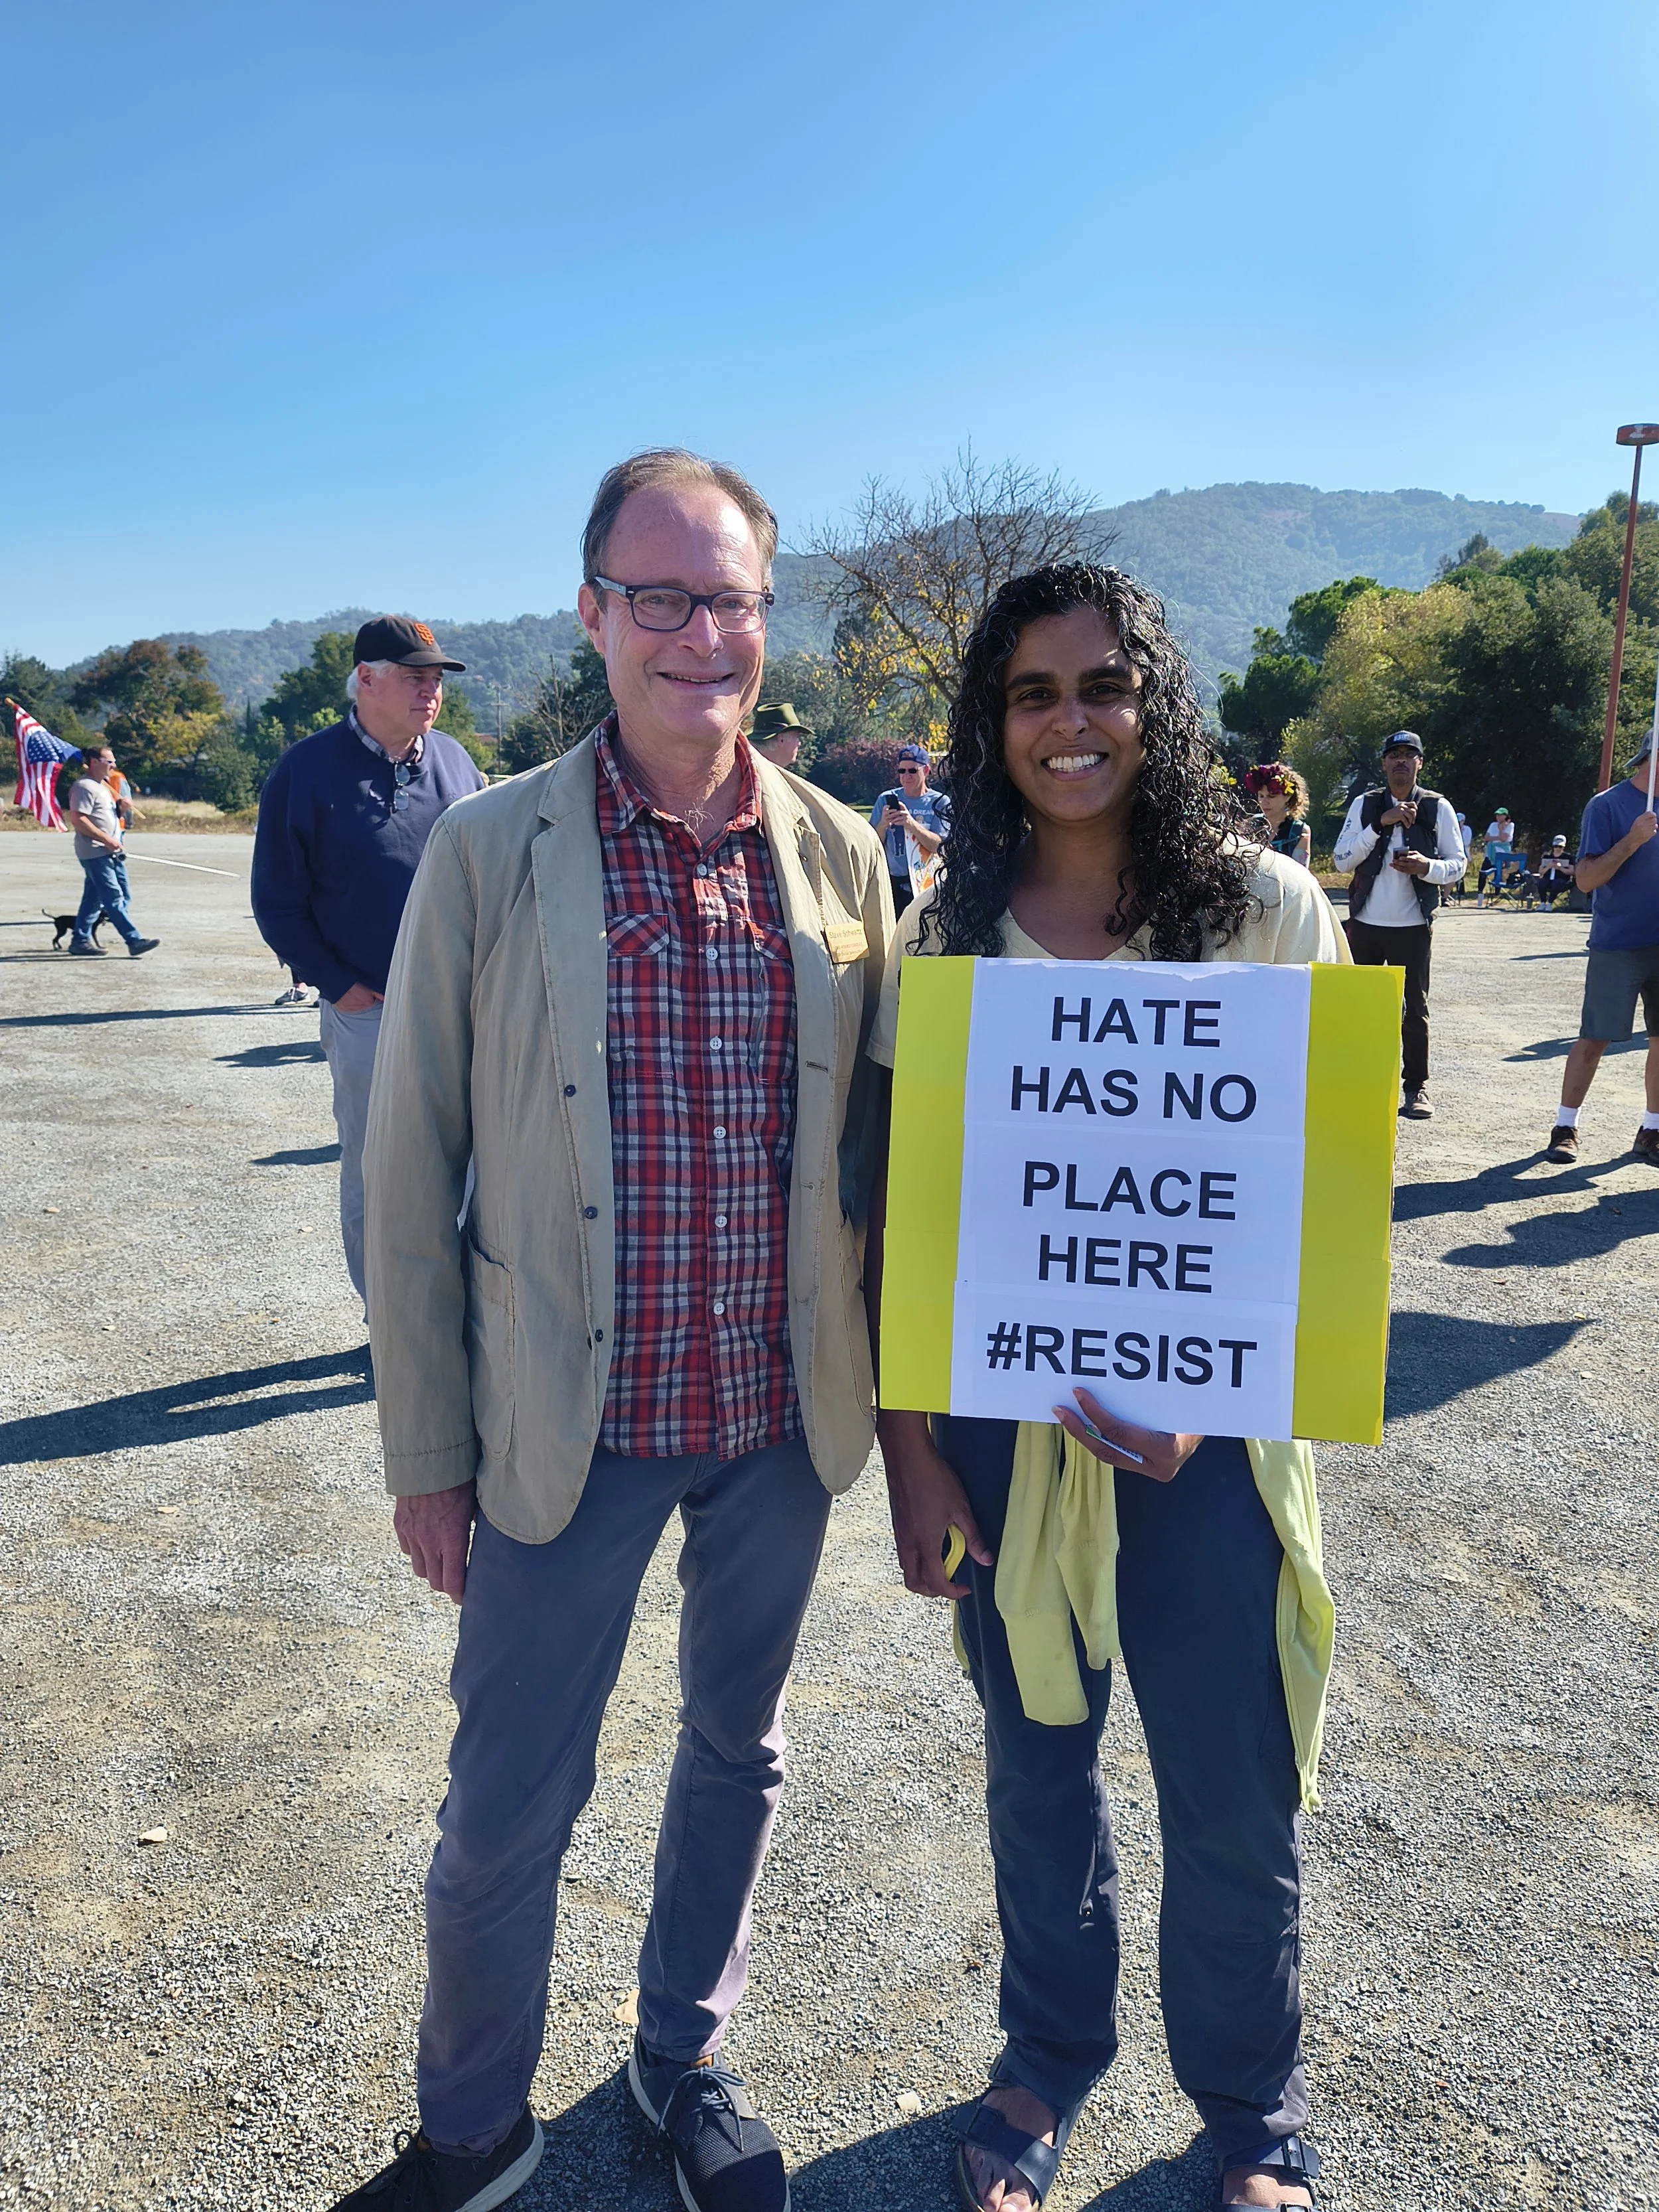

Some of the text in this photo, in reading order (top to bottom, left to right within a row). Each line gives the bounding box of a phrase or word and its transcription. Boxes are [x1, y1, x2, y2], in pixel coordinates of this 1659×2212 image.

[1051, 996, 1222, 1048] HATE
[1011, 1065, 1257, 1123] HAS NO
[1023, 1161, 1237, 1220] PLACE
[1039, 1234, 1213, 1293] HERE
[986, 1321, 1258, 1388] #RESIST
